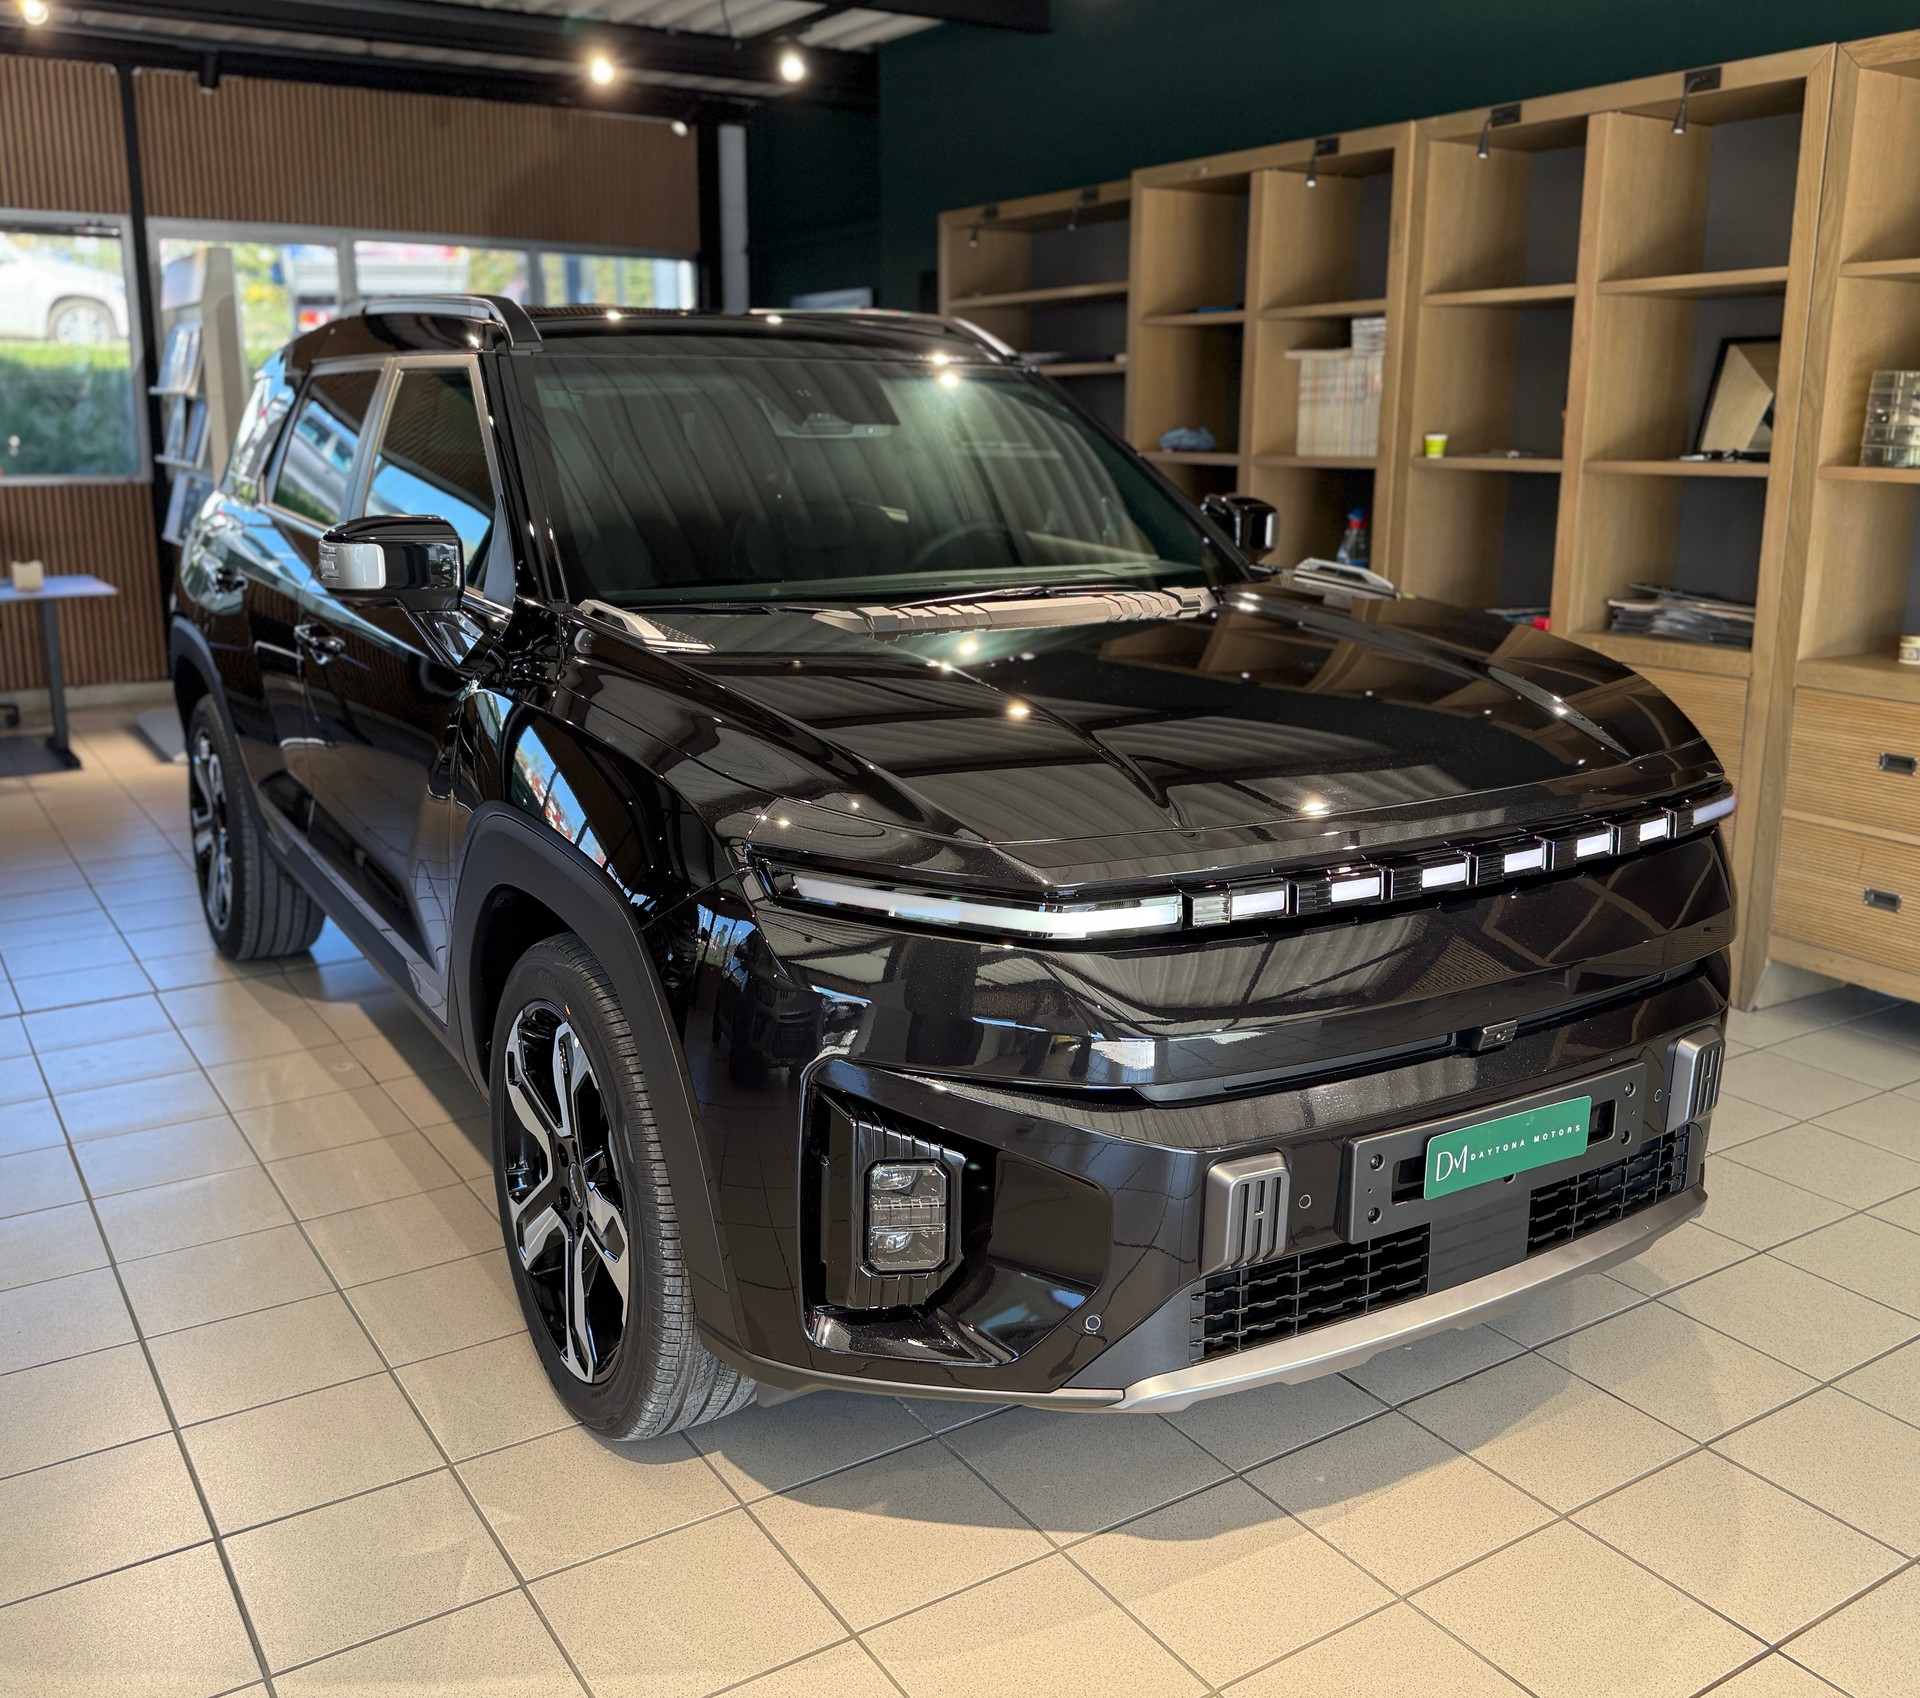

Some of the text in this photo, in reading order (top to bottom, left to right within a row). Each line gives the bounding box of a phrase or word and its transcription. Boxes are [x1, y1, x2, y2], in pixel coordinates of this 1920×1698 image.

[1435, 1124, 1581, 1182] DM DAYTONA MOTORS
